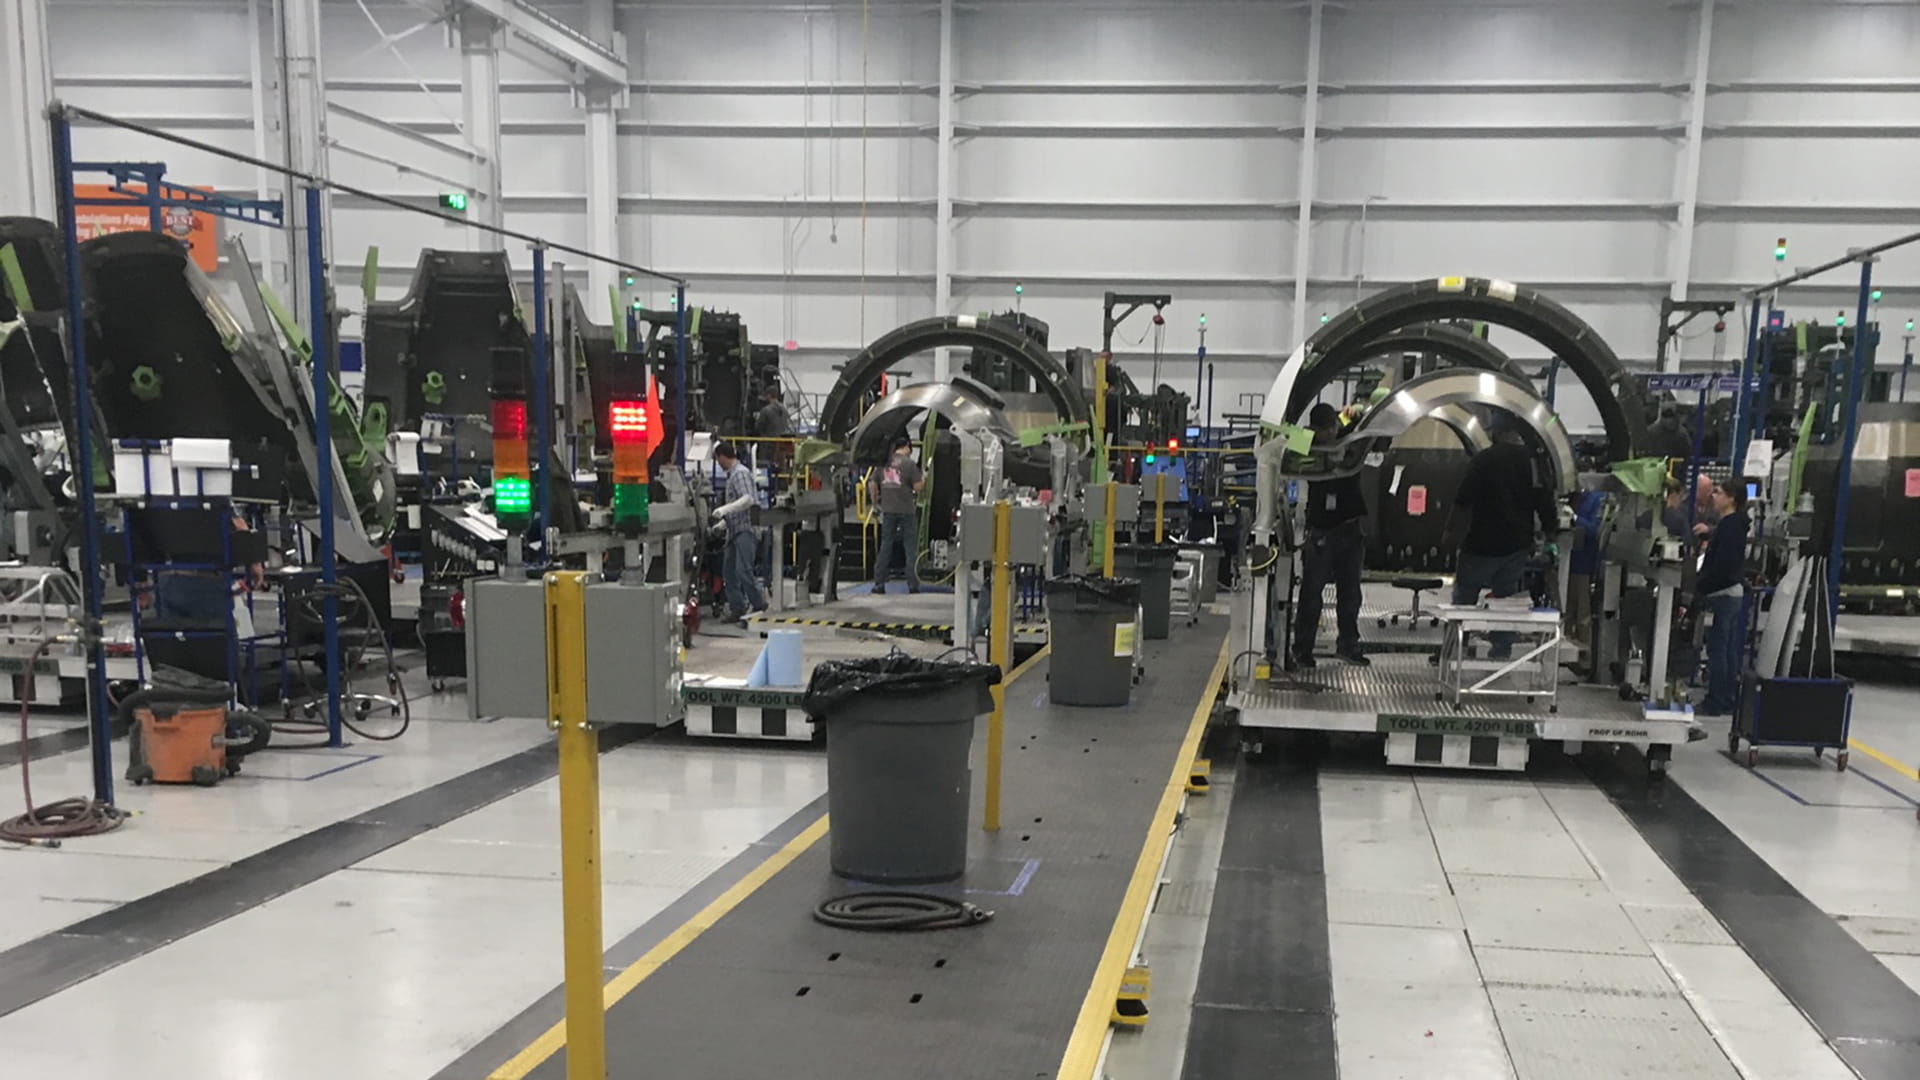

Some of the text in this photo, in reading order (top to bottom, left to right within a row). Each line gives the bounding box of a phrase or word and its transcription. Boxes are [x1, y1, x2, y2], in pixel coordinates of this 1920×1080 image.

[687, 691, 716, 701] OOL
[748, 694, 780, 705] 4200
[786, 695, 802, 705] LB
[1390, 718, 1535, 734] TOOL WT. 4200 LBS
